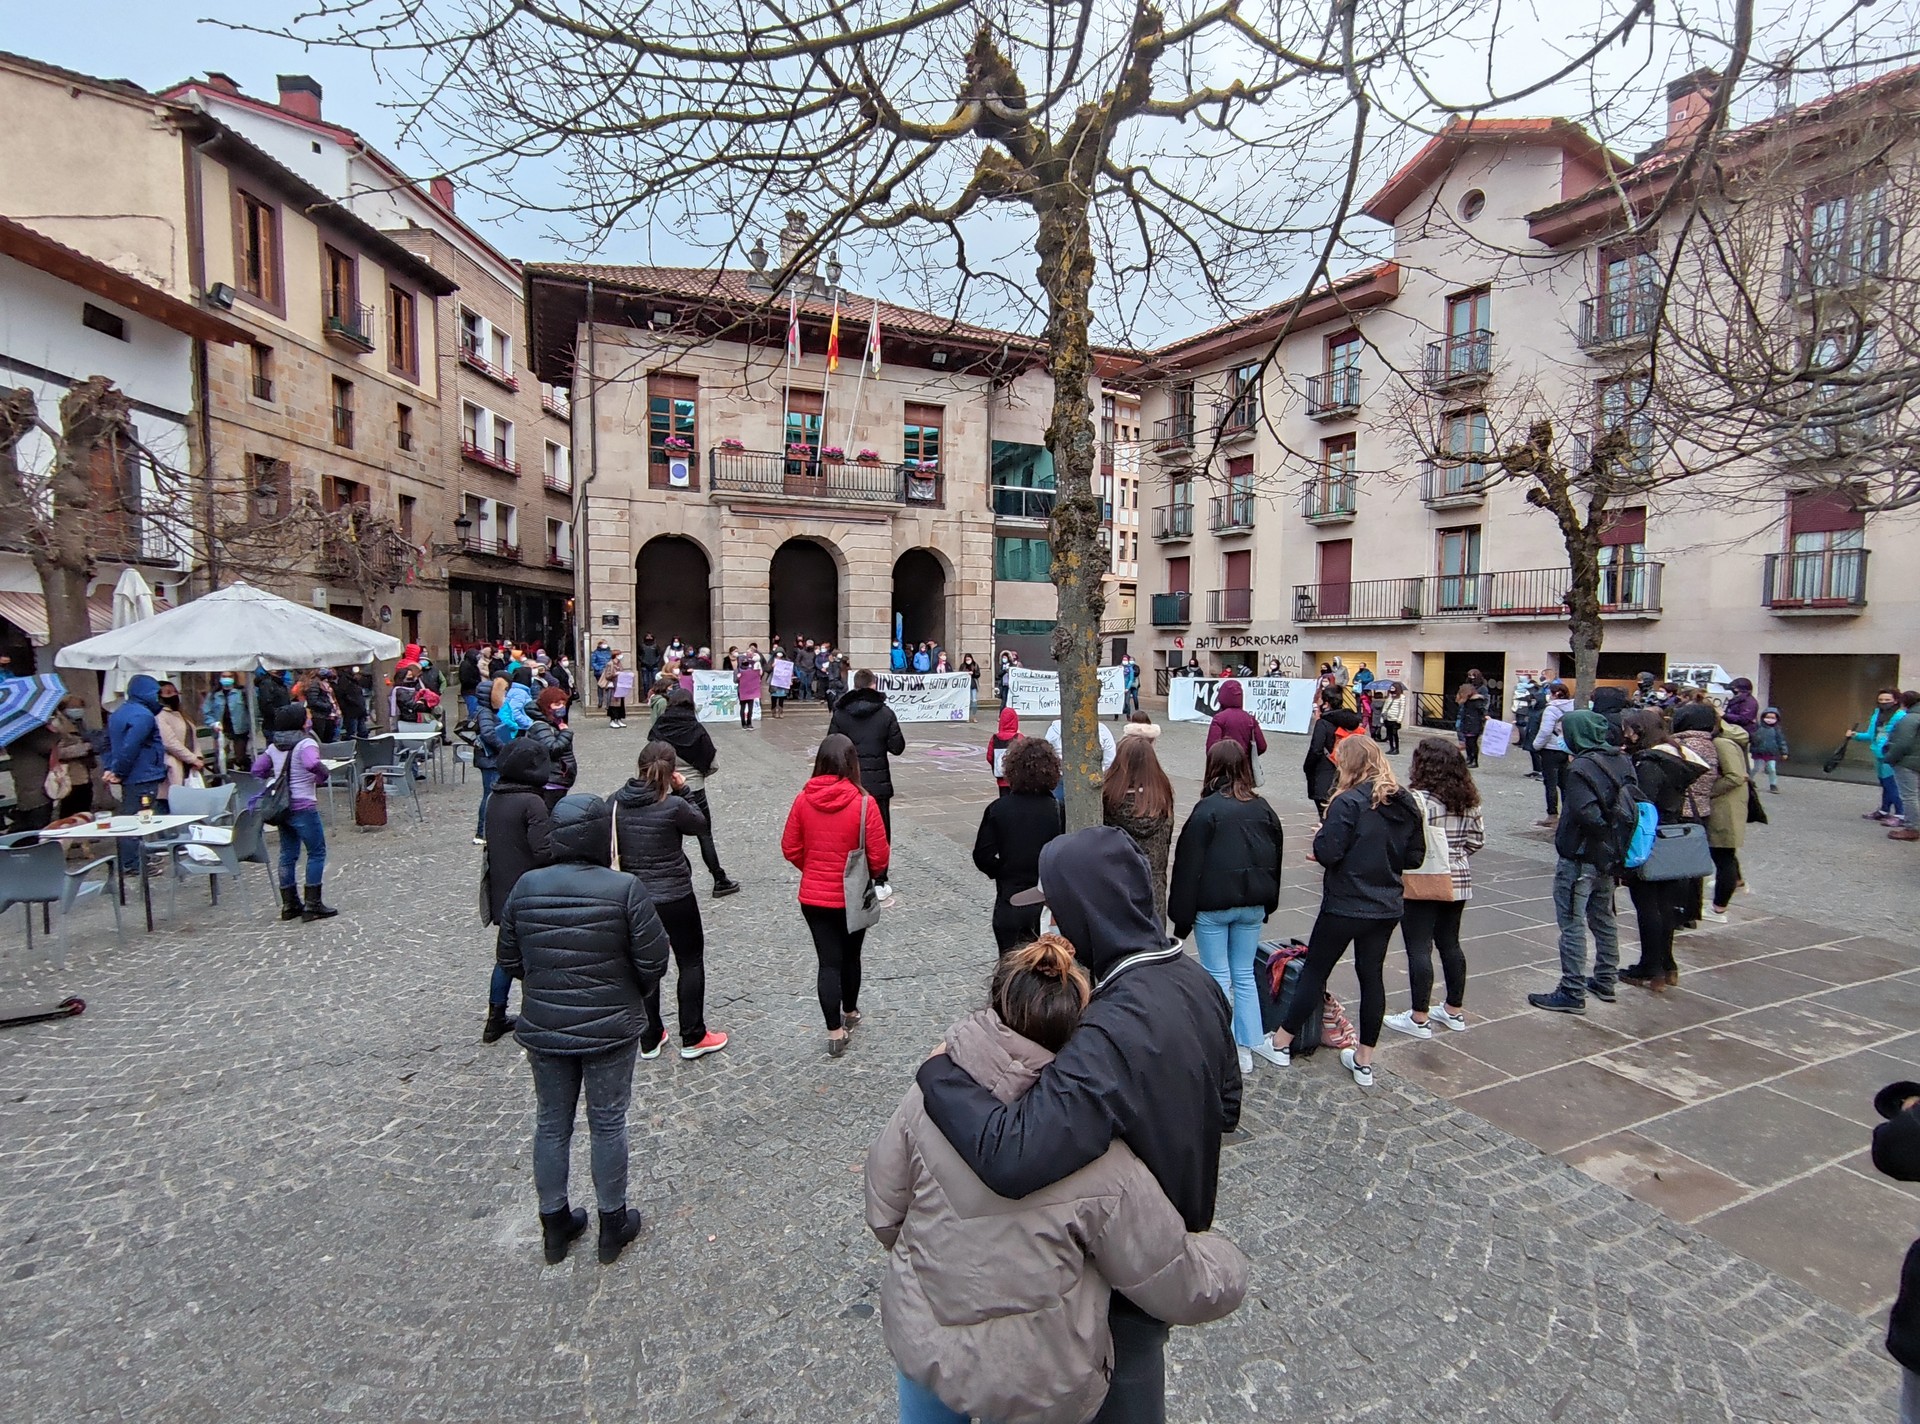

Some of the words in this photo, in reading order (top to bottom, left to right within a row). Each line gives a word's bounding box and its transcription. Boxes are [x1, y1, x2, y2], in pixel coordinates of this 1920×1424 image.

[1196, 637, 1223, 649] BATU
[1230, 634, 1299, 648] BORROKARA
[886, 691, 932, 704] erri
[1011, 695, 1031, 710] ETA
[1038, 694, 1061, 710] KONFIN
[1256, 698, 1287, 712] SISTEMA
